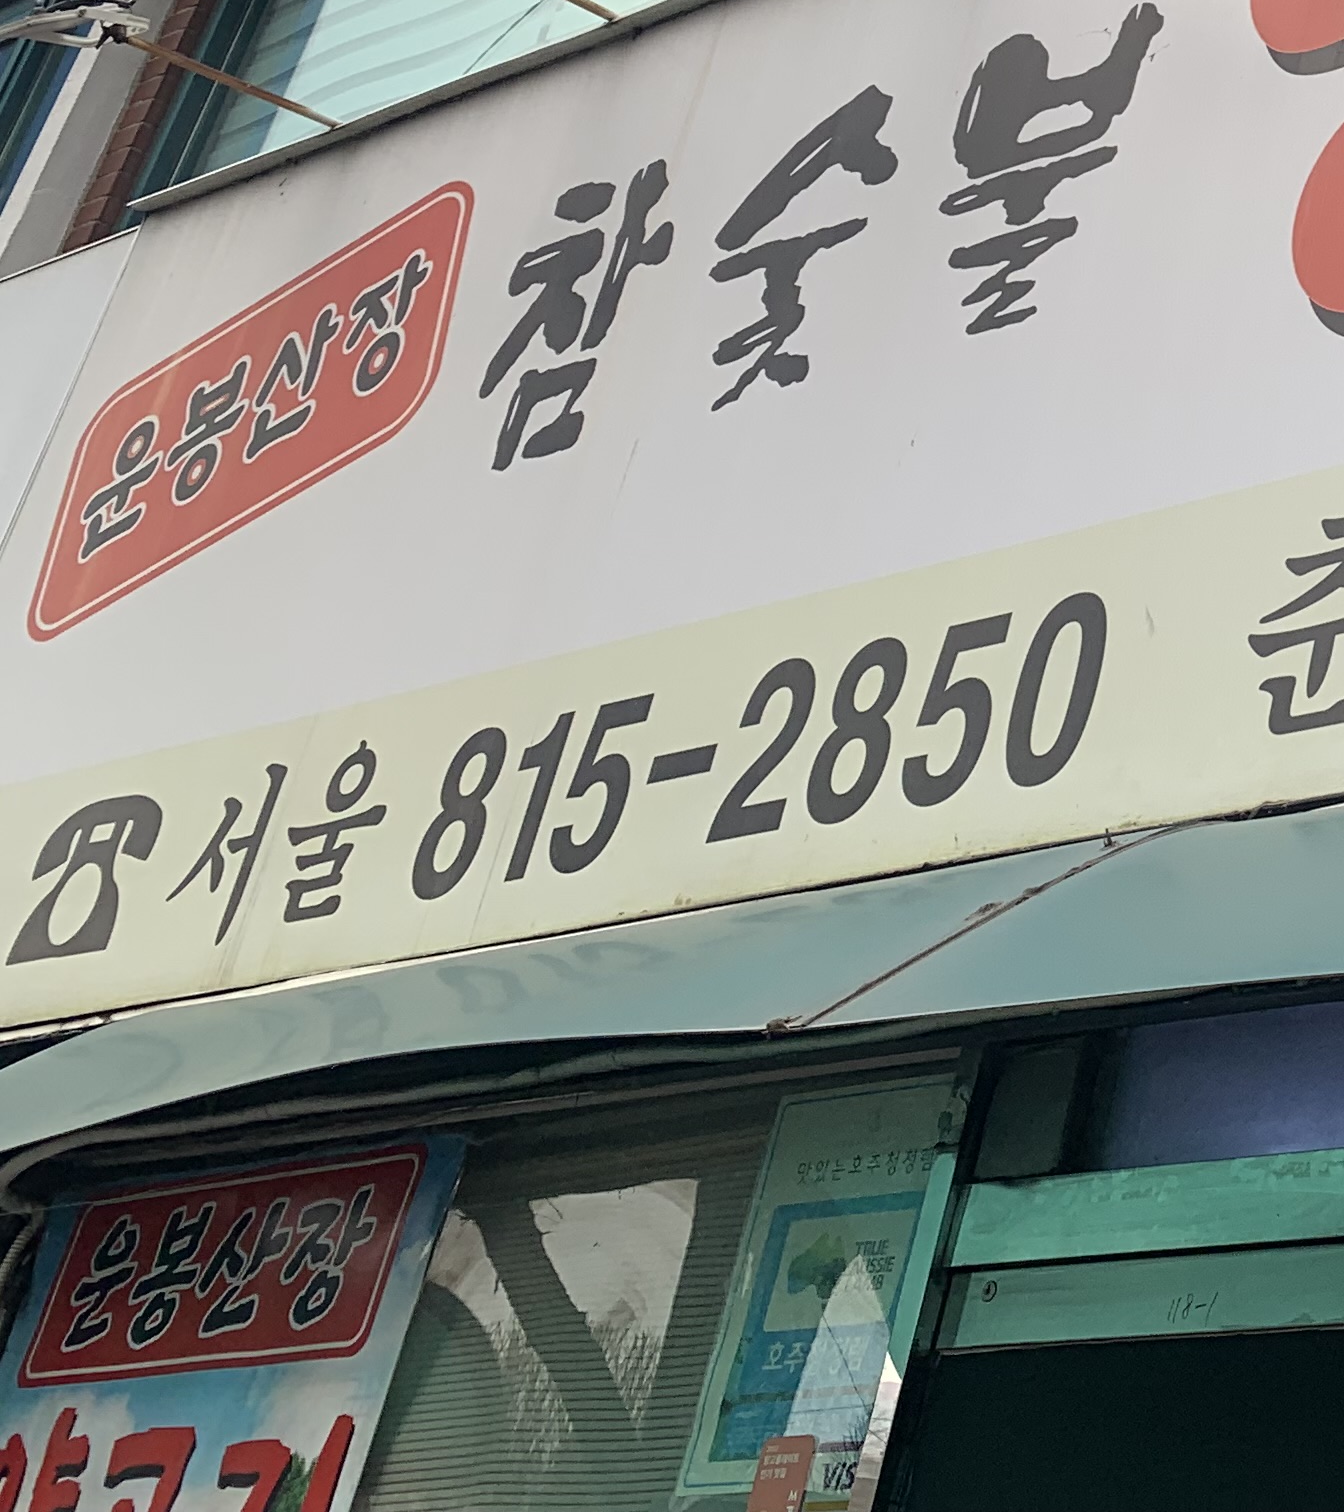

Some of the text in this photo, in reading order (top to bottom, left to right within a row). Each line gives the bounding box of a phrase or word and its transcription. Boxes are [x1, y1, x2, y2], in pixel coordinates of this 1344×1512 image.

[480, 2, 1164, 470] 참숯불
[78, 253, 432, 564] 운봉산장
[167, 739, 386, 945] 서울
[411, 592, 1107, 900] 815-2850
[60, 1183, 378, 1351] 운봉산장
[822, 1461, 857, 1490] VIS
